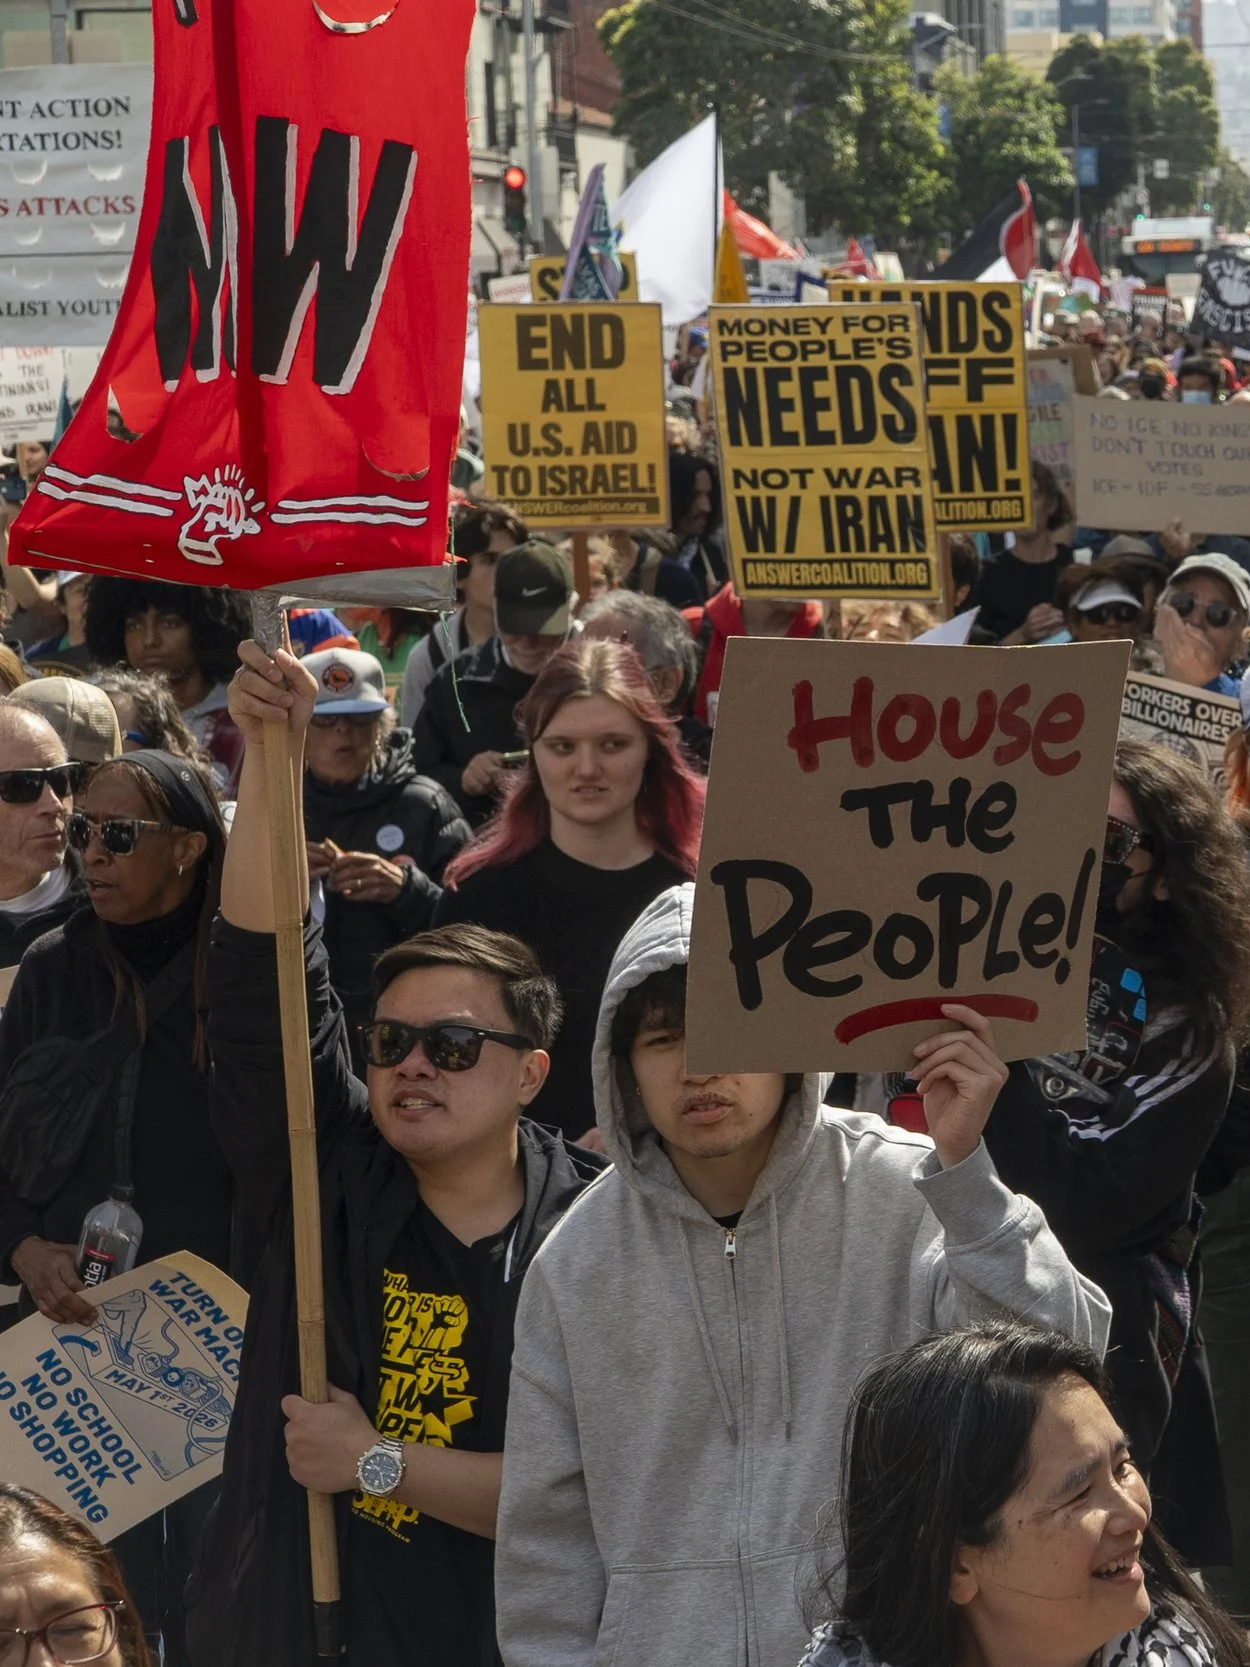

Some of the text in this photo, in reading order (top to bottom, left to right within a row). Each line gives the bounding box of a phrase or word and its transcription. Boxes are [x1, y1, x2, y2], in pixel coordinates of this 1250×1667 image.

[29, 96, 130, 119] ACTION
[16, 195, 135, 216] ATTACKS
[516, 313, 625, 370] END
[717, 315, 911, 337] MONEY FOR
[720, 336, 912, 362] PEOPLE'S
[541, 378, 606, 413] ALL
[927, 358, 1015, 403] FF
[723, 364, 917, 447] NEEDS
[1090, 413, 1117, 430] NO
[1128, 416, 1159, 434] ICE
[1173, 421, 1201, 436] NO
[507, 420, 637, 456] U.S. AID
[929, 414, 1021, 495] AN!
[1156, 440, 1215, 459] TOUCH
[492, 463, 656, 496] TO ISRAEL!
[733, 468, 921, 490] NOT WAR
[736, 494, 927, 554] W/ IRAN
[746, 562, 928, 585] ANSWERCOALITION.ORG
[1122, 699, 1230, 741] BILLIONAIRES
[1126, 683, 1243, 728] ORKERS OVER
[148, 1280, 200, 1333] WAR
[168, 1272, 227, 1328] TURN
[35, 1348, 143, 1486] NO SCHOOL
[104, 1369, 145, 1394] MAY
[173, 1400, 219, 1430] 2026
[21, 1375, 117, 1489] NO WORK
[9, 1401, 109, 1525] SHOPPING
